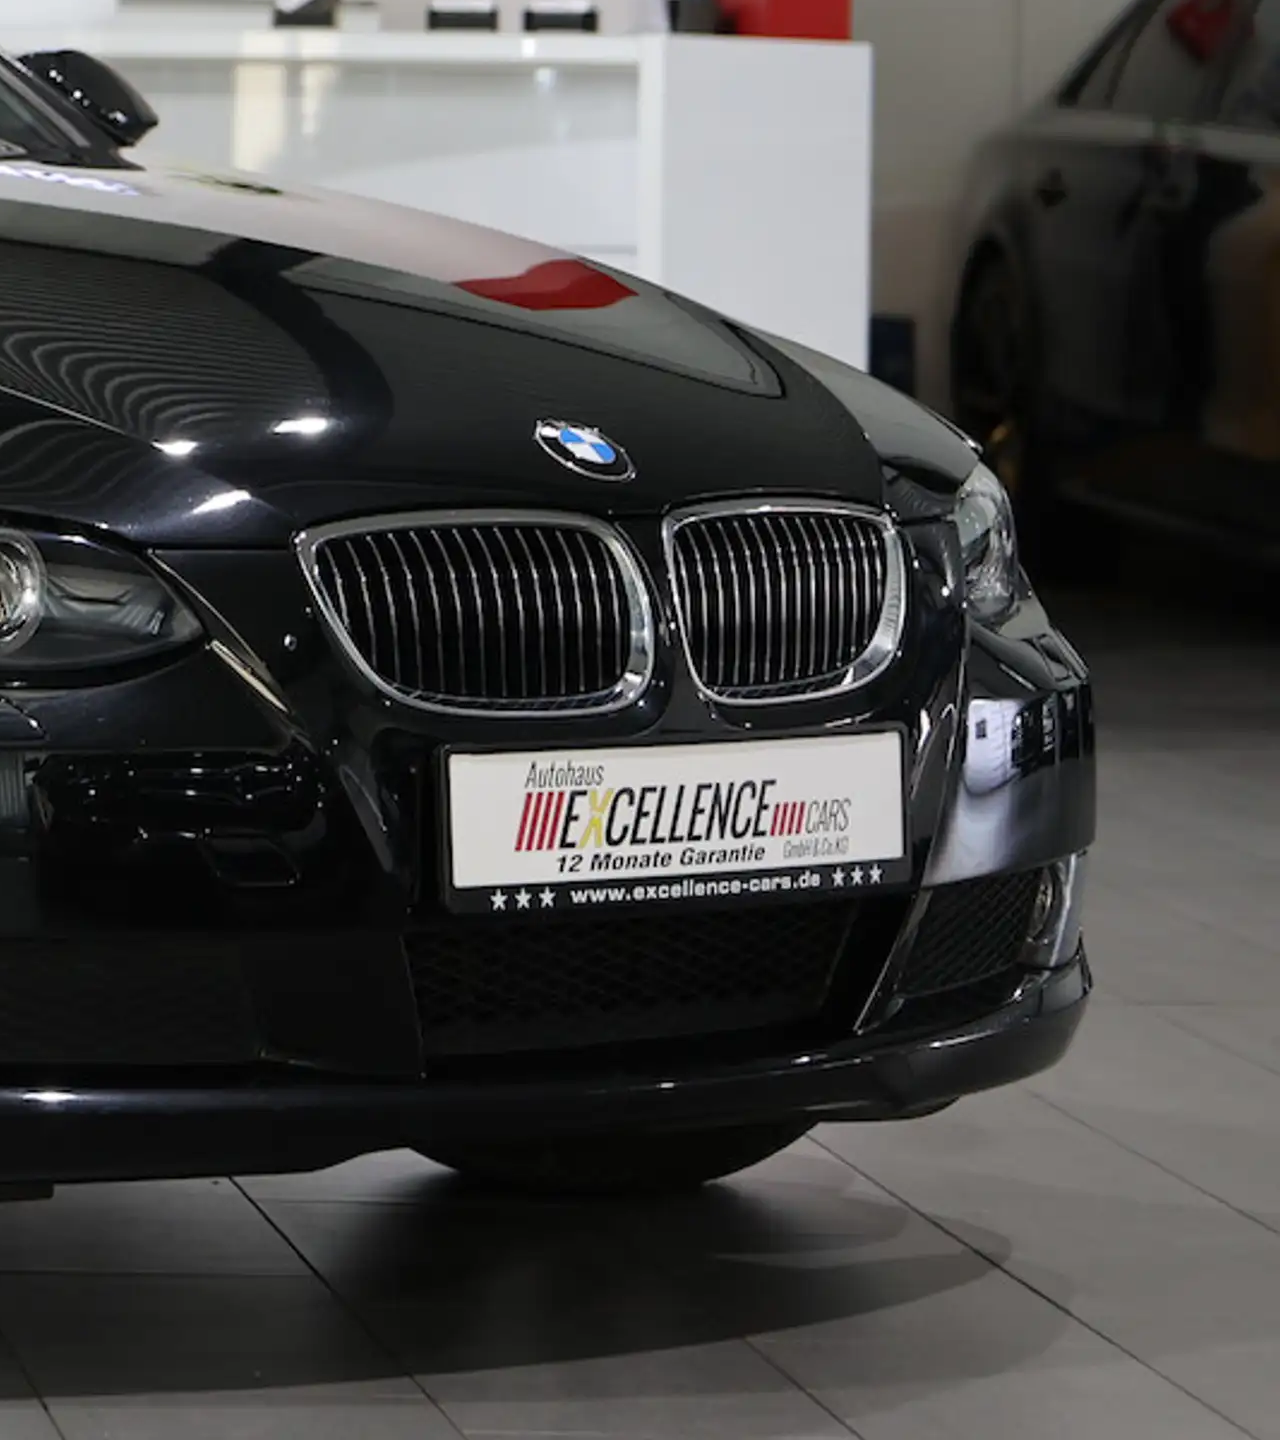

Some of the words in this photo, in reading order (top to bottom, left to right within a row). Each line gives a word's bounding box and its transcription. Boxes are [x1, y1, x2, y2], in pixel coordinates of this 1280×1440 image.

[524, 760, 605, 789] Autohaus
[558, 778, 777, 851] EXCELLENCE
[804, 797, 852, 835] CARS
[556, 853, 584, 873] 12
[589, 849, 672, 872] Monate
[679, 843, 766, 866] Garantie
[570, 869, 821, 905] www.excellence-cars.de
